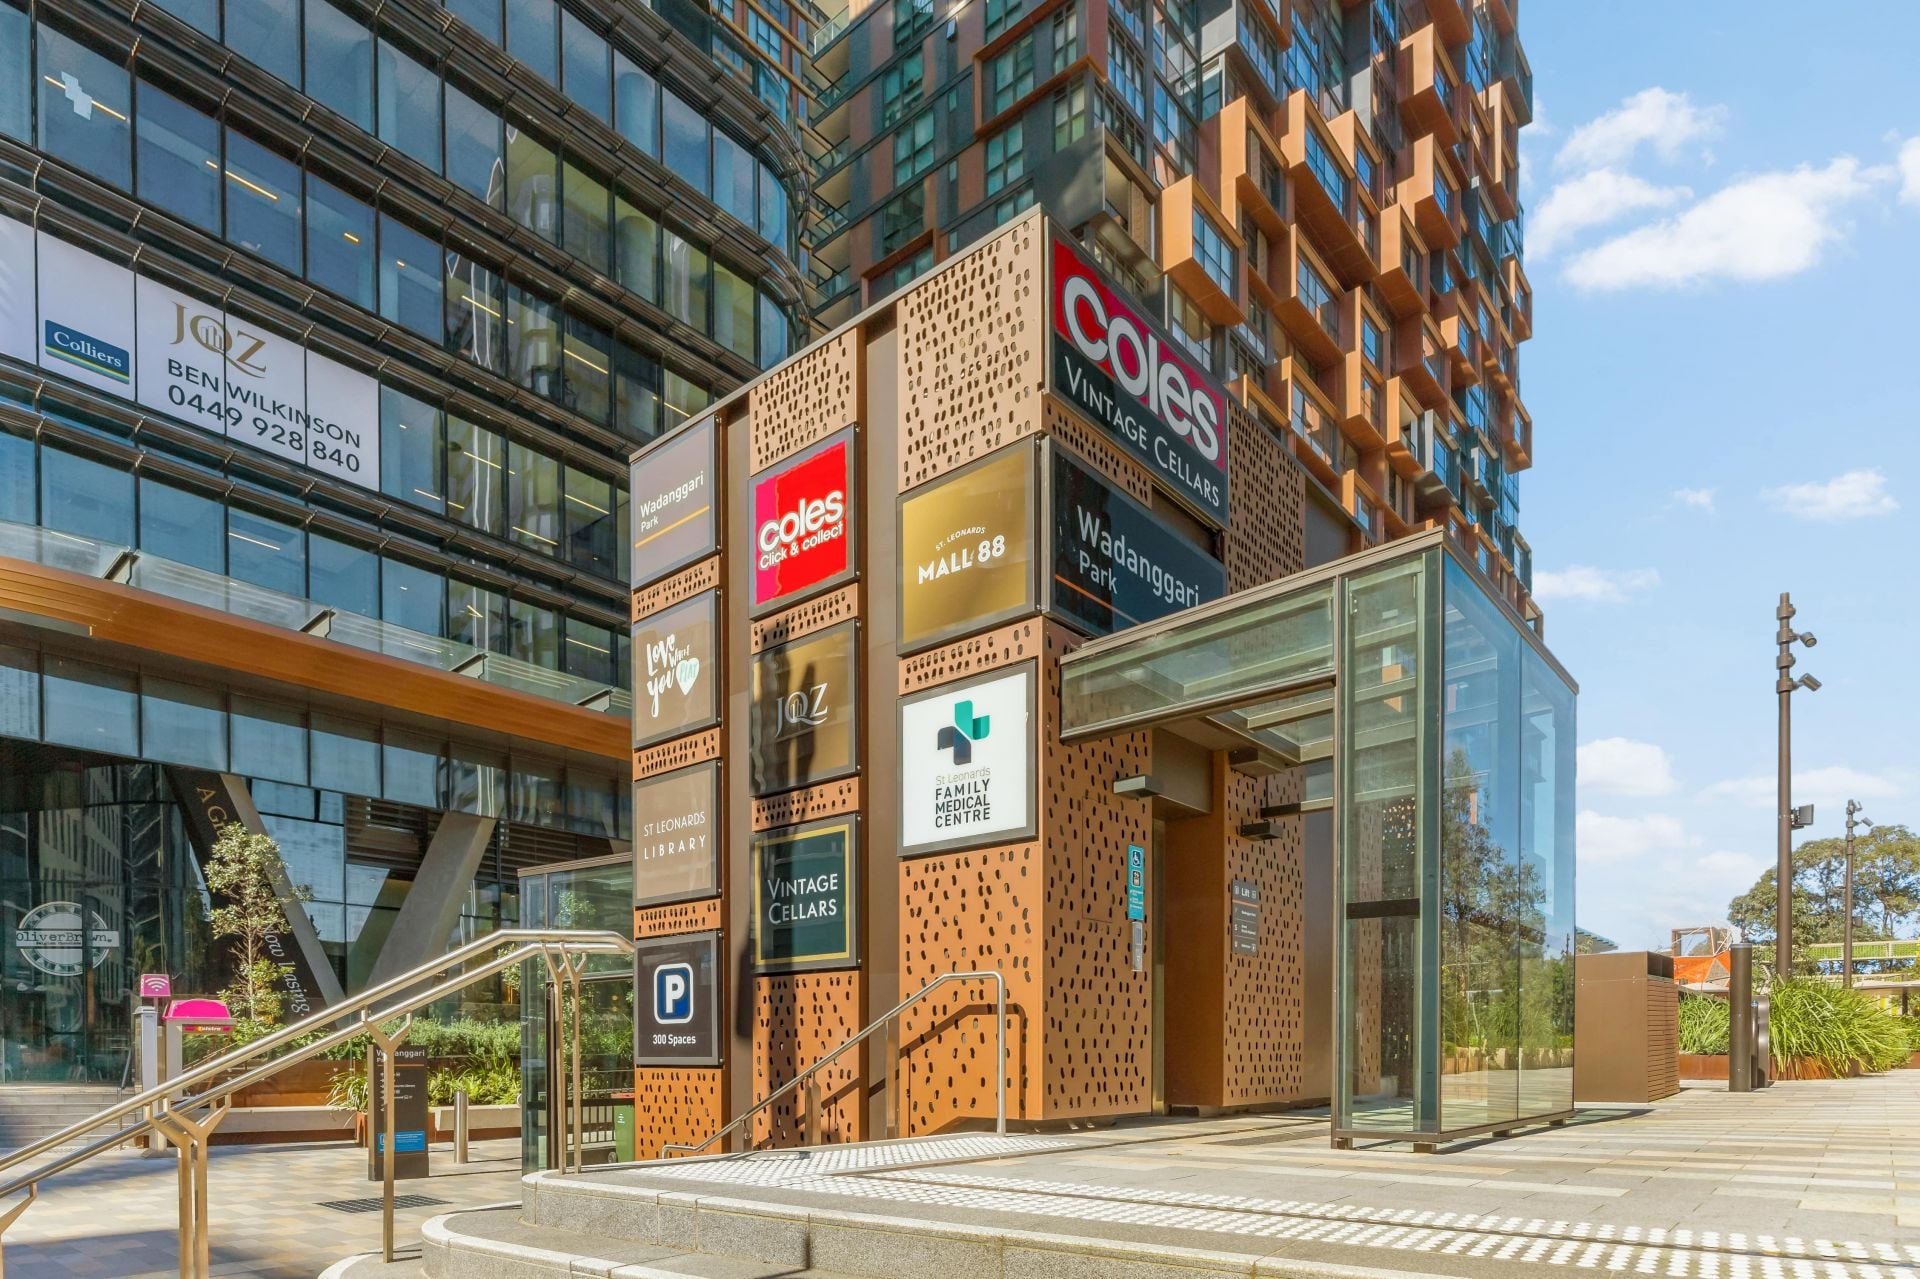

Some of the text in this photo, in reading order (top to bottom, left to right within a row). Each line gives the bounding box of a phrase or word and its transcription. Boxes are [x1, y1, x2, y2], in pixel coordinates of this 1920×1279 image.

[53, 331, 122, 369] Colliers
[170, 302, 267, 379] JQZ
[1064, 276, 1219, 461] coles
[168, 358, 361, 449] BEN WILKINSON
[168, 384, 360, 473] 0449 928 840
[1065, 355, 1219, 508] VINTAGE CELLARS
[640, 471, 704, 518] Wadanggari
[641, 518, 659, 532] Park
[760, 490, 844, 552] coles
[936, 526, 986, 551] ST. LEONARDS
[760, 523, 843, 569] Click & collect
[918, 534, 1005, 585] MALL 88
[1077, 505, 1199, 607] Wadanggari
[1079, 549, 1118, 595] Park
[646, 668, 675, 718] you
[775, 682, 828, 738] JQZ
[935, 778, 990, 800] FAMILY
[936, 766, 991, 786] St Leonards
[644, 812, 705, 837] ST LEONARDS
[935, 794, 990, 815] MEDICAL
[935, 807, 990, 828] CENTRE
[644, 835, 706, 860] LIBRARY
[768, 874, 838, 900] VINTAGE
[769, 899, 837, 925] CELLARS
[665, 974, 685, 1014] P
[653, 1033, 696, 1046] 300 Spaces
